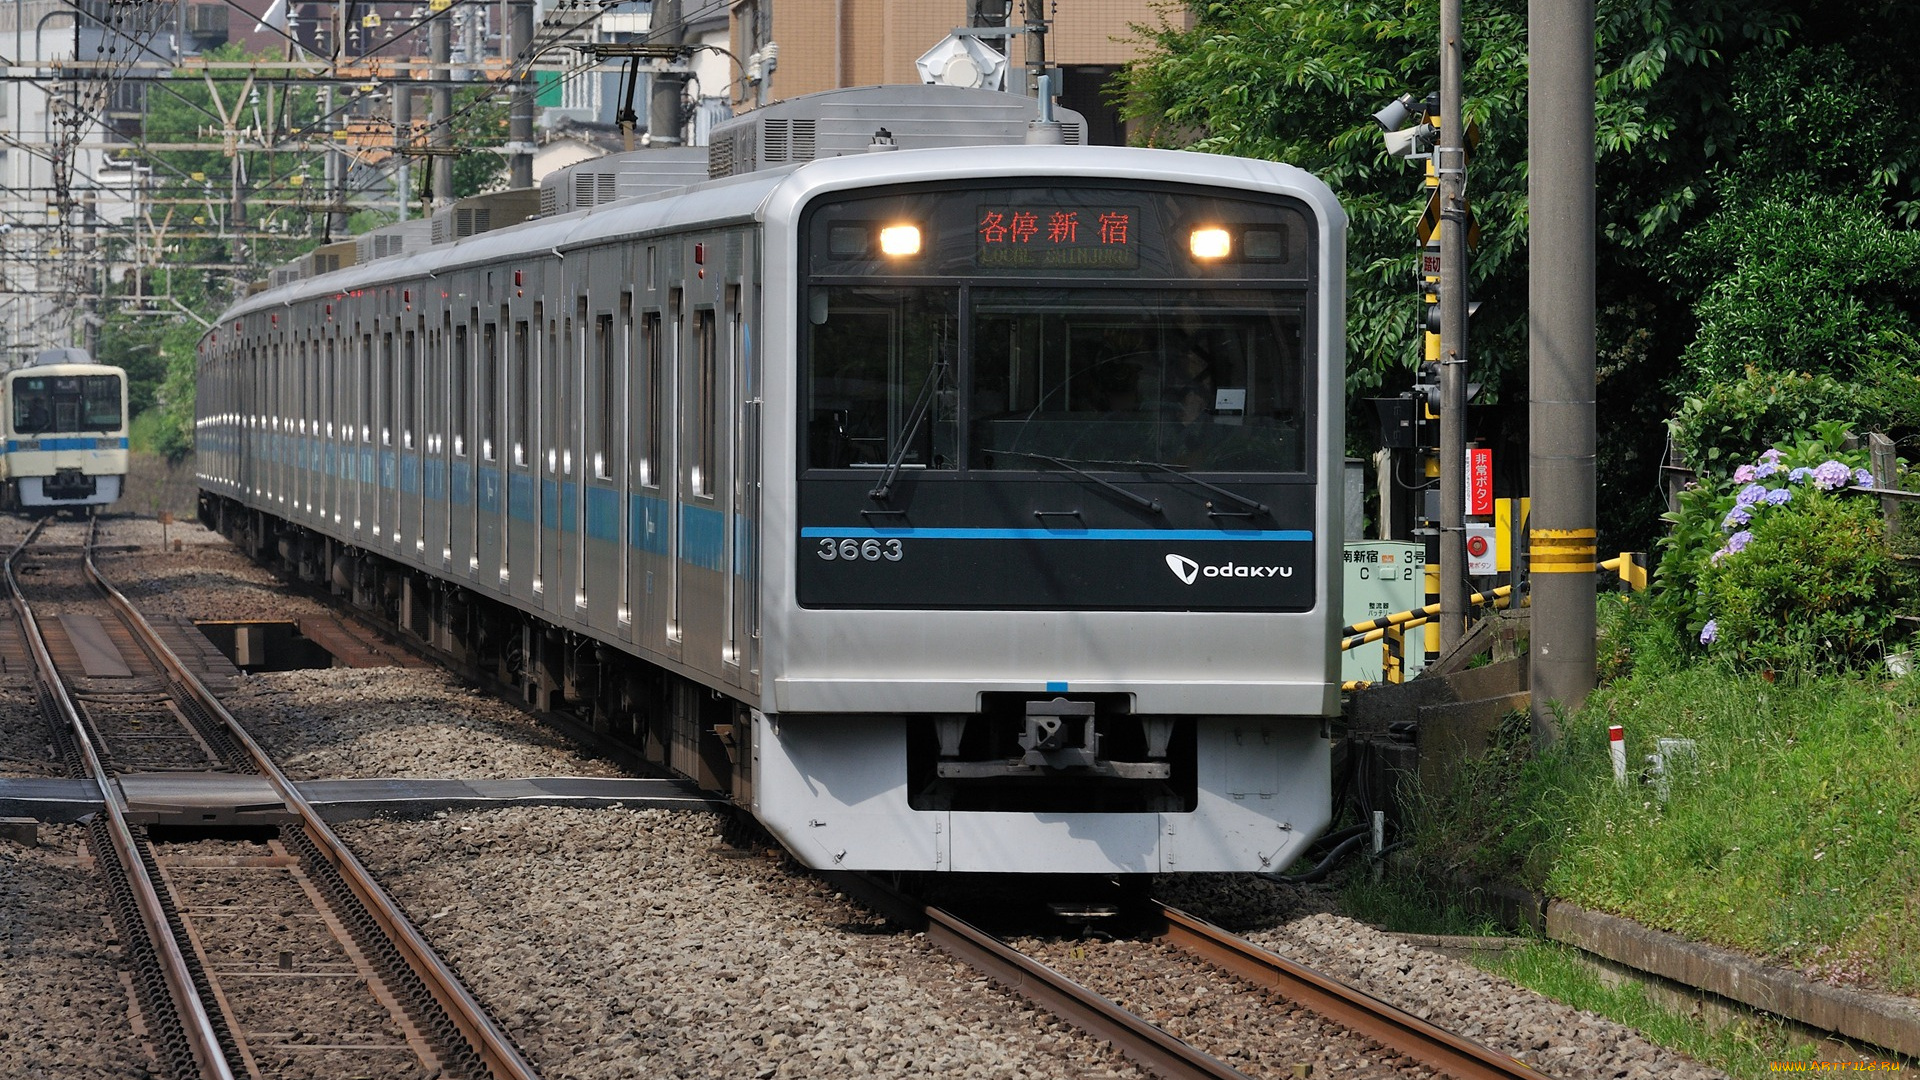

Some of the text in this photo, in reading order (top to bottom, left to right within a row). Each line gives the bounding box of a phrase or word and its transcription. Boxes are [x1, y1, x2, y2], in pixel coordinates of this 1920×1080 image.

[980, 211, 1039, 243] 各停
[981, 246, 1032, 263] LOCAL
[1424, 256, 1440, 272] 踏切
[1475, 453, 1489, 511] 非常ボタン
[817, 538, 904, 561] 3663
[1344, 550, 1379, 563] 南新宿
[1360, 567, 1413, 581] C 2
